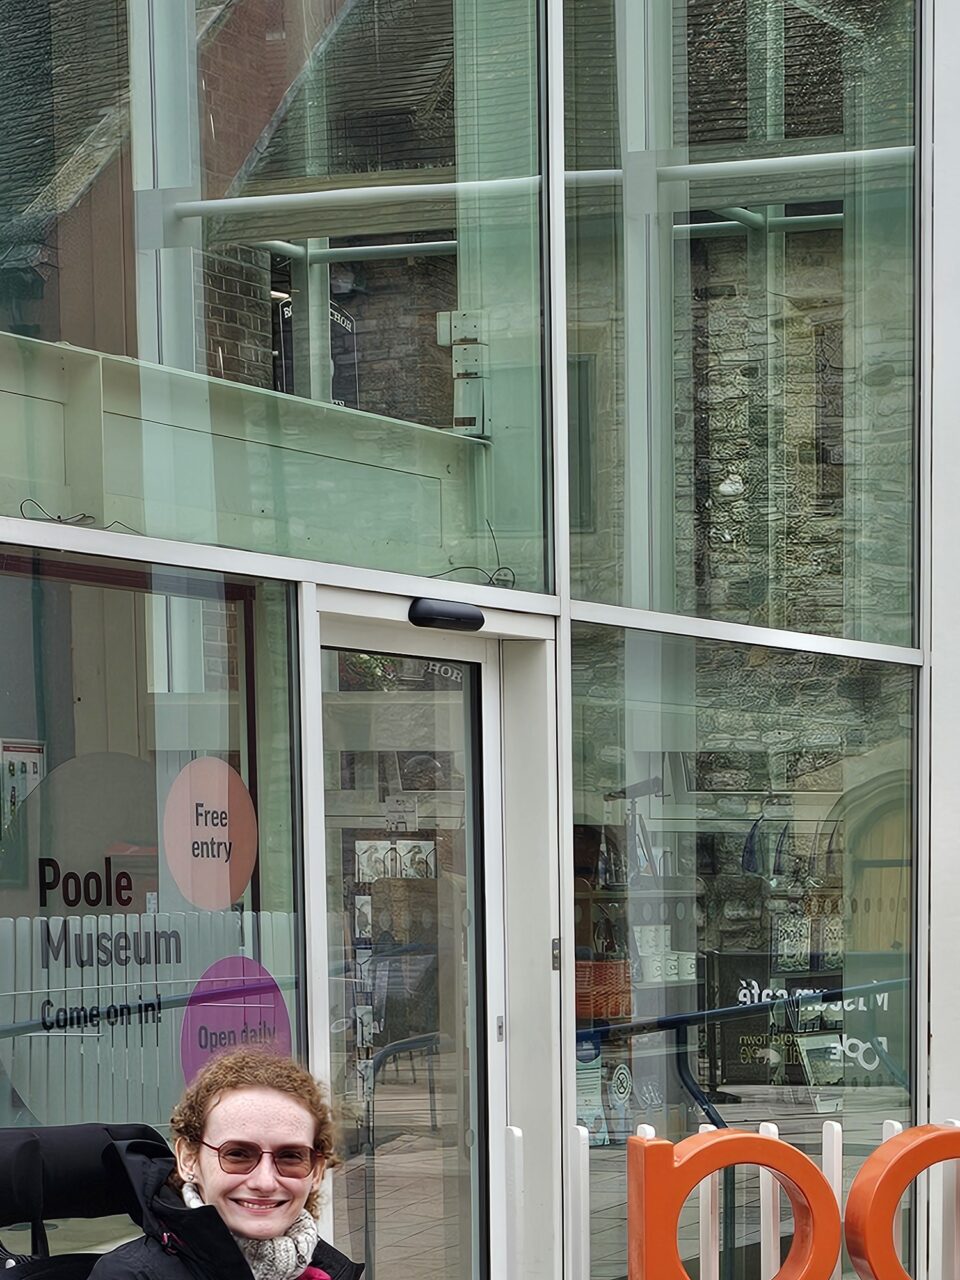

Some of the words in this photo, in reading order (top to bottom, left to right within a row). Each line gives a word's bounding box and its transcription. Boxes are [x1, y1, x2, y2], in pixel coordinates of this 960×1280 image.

[195, 802, 228, 827] Free
[191, 837, 232, 863] entry
[38, 856, 133, 908] Poole
[40, 918, 182, 969] Museum
[41, 1000, 100, 1030] Come
[106, 1003, 132, 1026] on
[138, 993, 162, 1024] in!
[198, 1025, 237, 1053] Open
